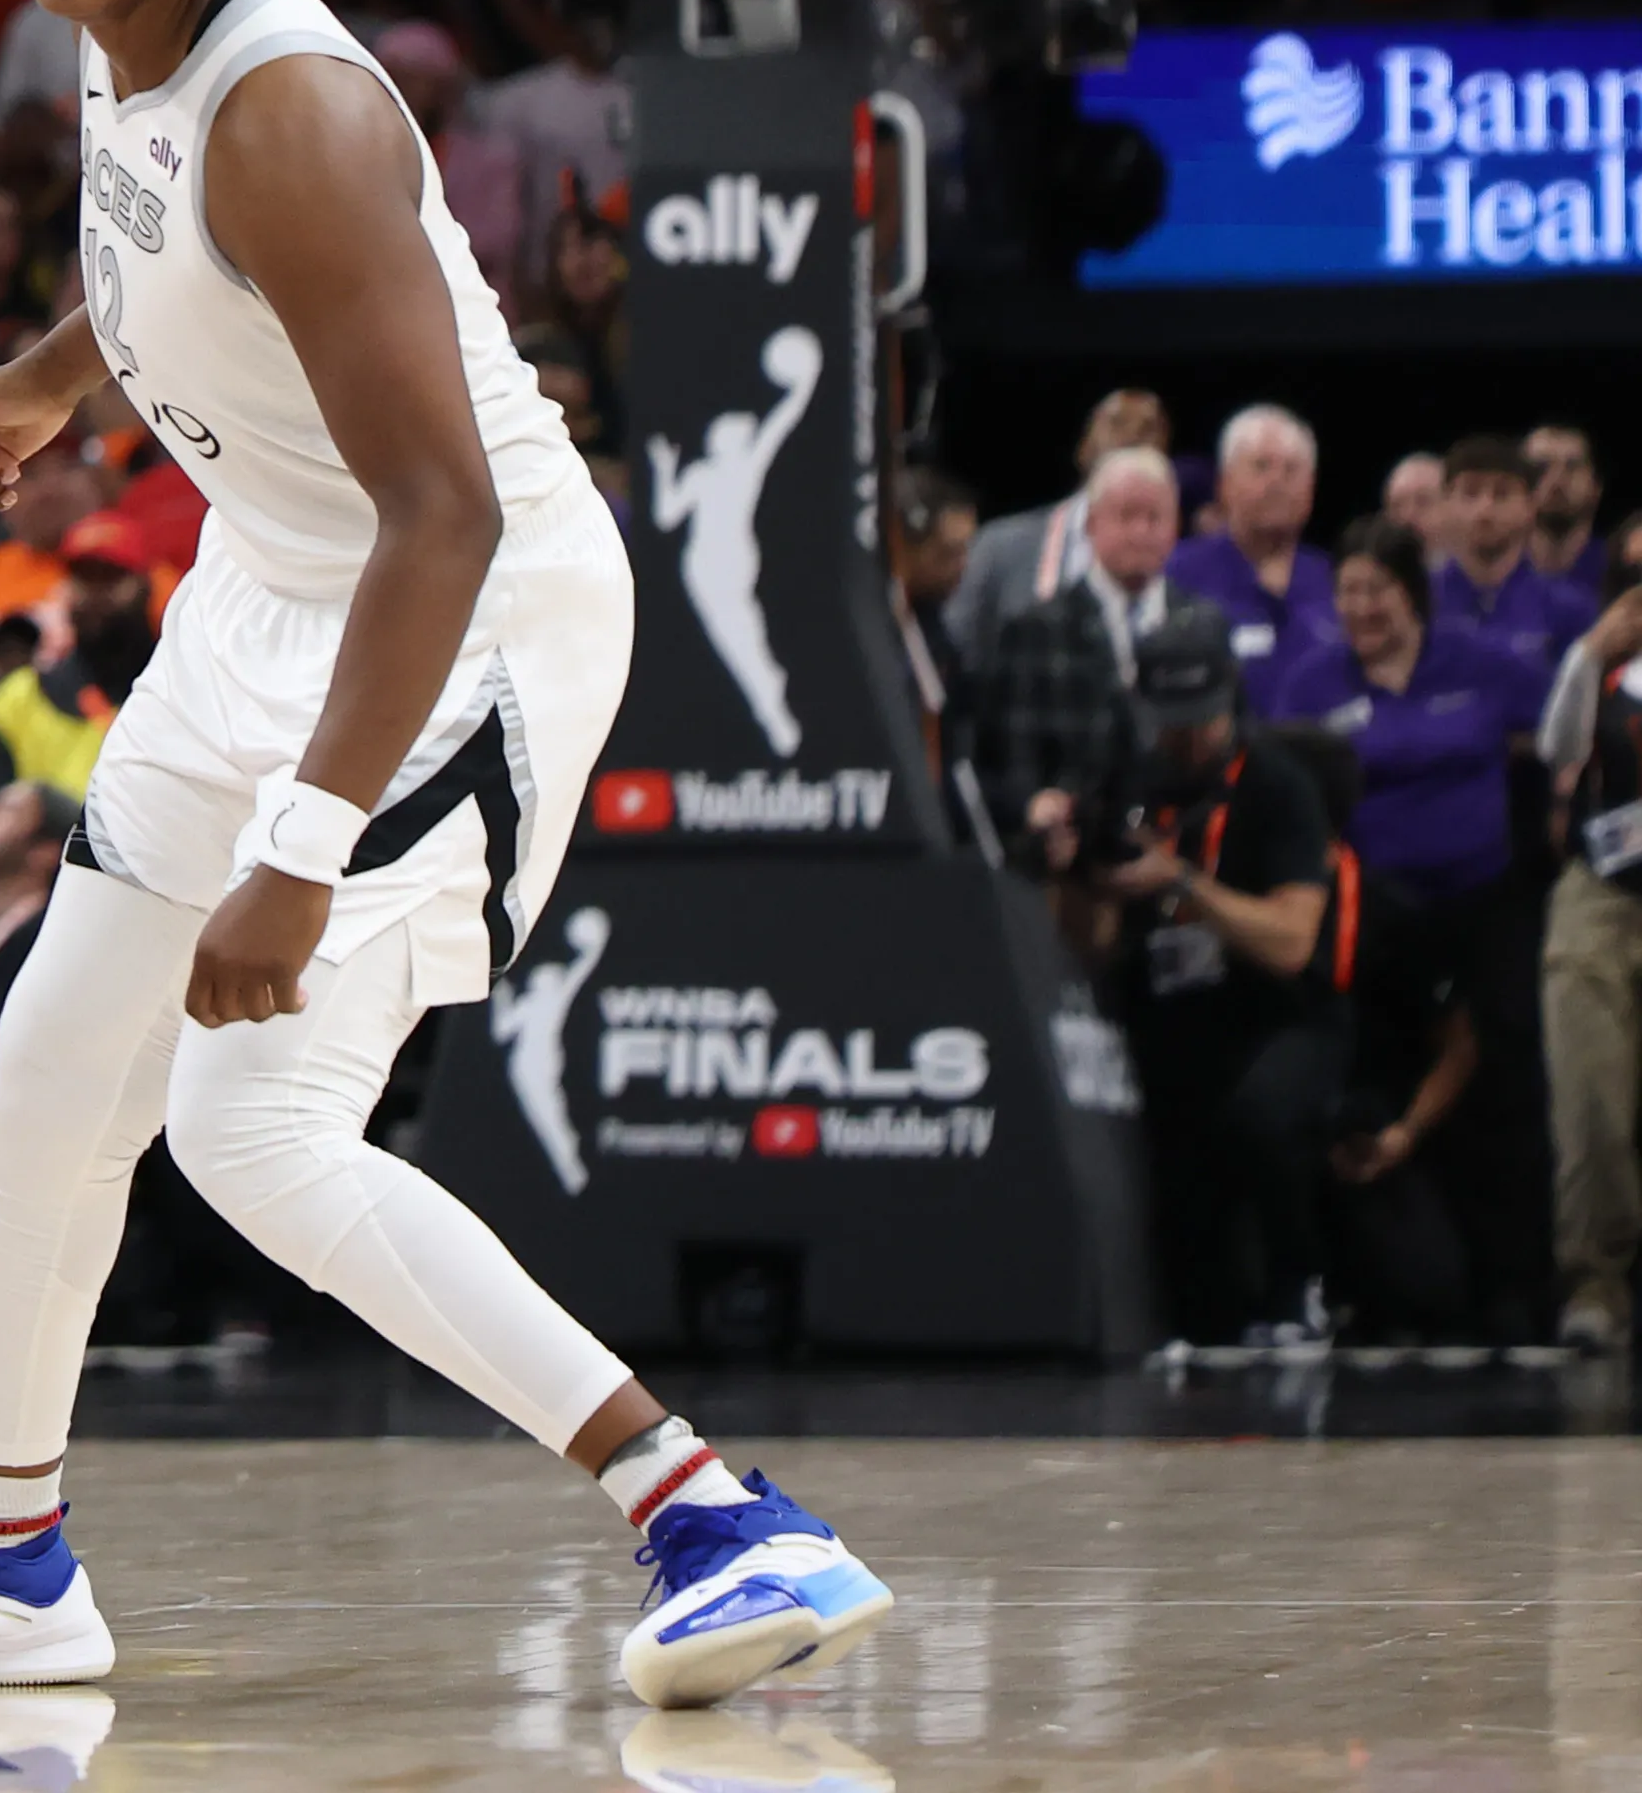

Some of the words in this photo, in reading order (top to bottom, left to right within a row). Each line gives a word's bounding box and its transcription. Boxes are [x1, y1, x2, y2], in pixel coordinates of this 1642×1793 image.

[81, 126, 166, 254] ACES
[149, 136, 182, 182] ally
[644, 170, 819, 285] ally
[674, 769, 833, 831] YouTube
[835, 768, 892, 831] TV
[599, 987, 776, 1025] WNBA
[599, 1027, 990, 1101] FINALS
[821, 1108, 946, 1157] YouTube
[948, 1108, 996, 1157] TV
